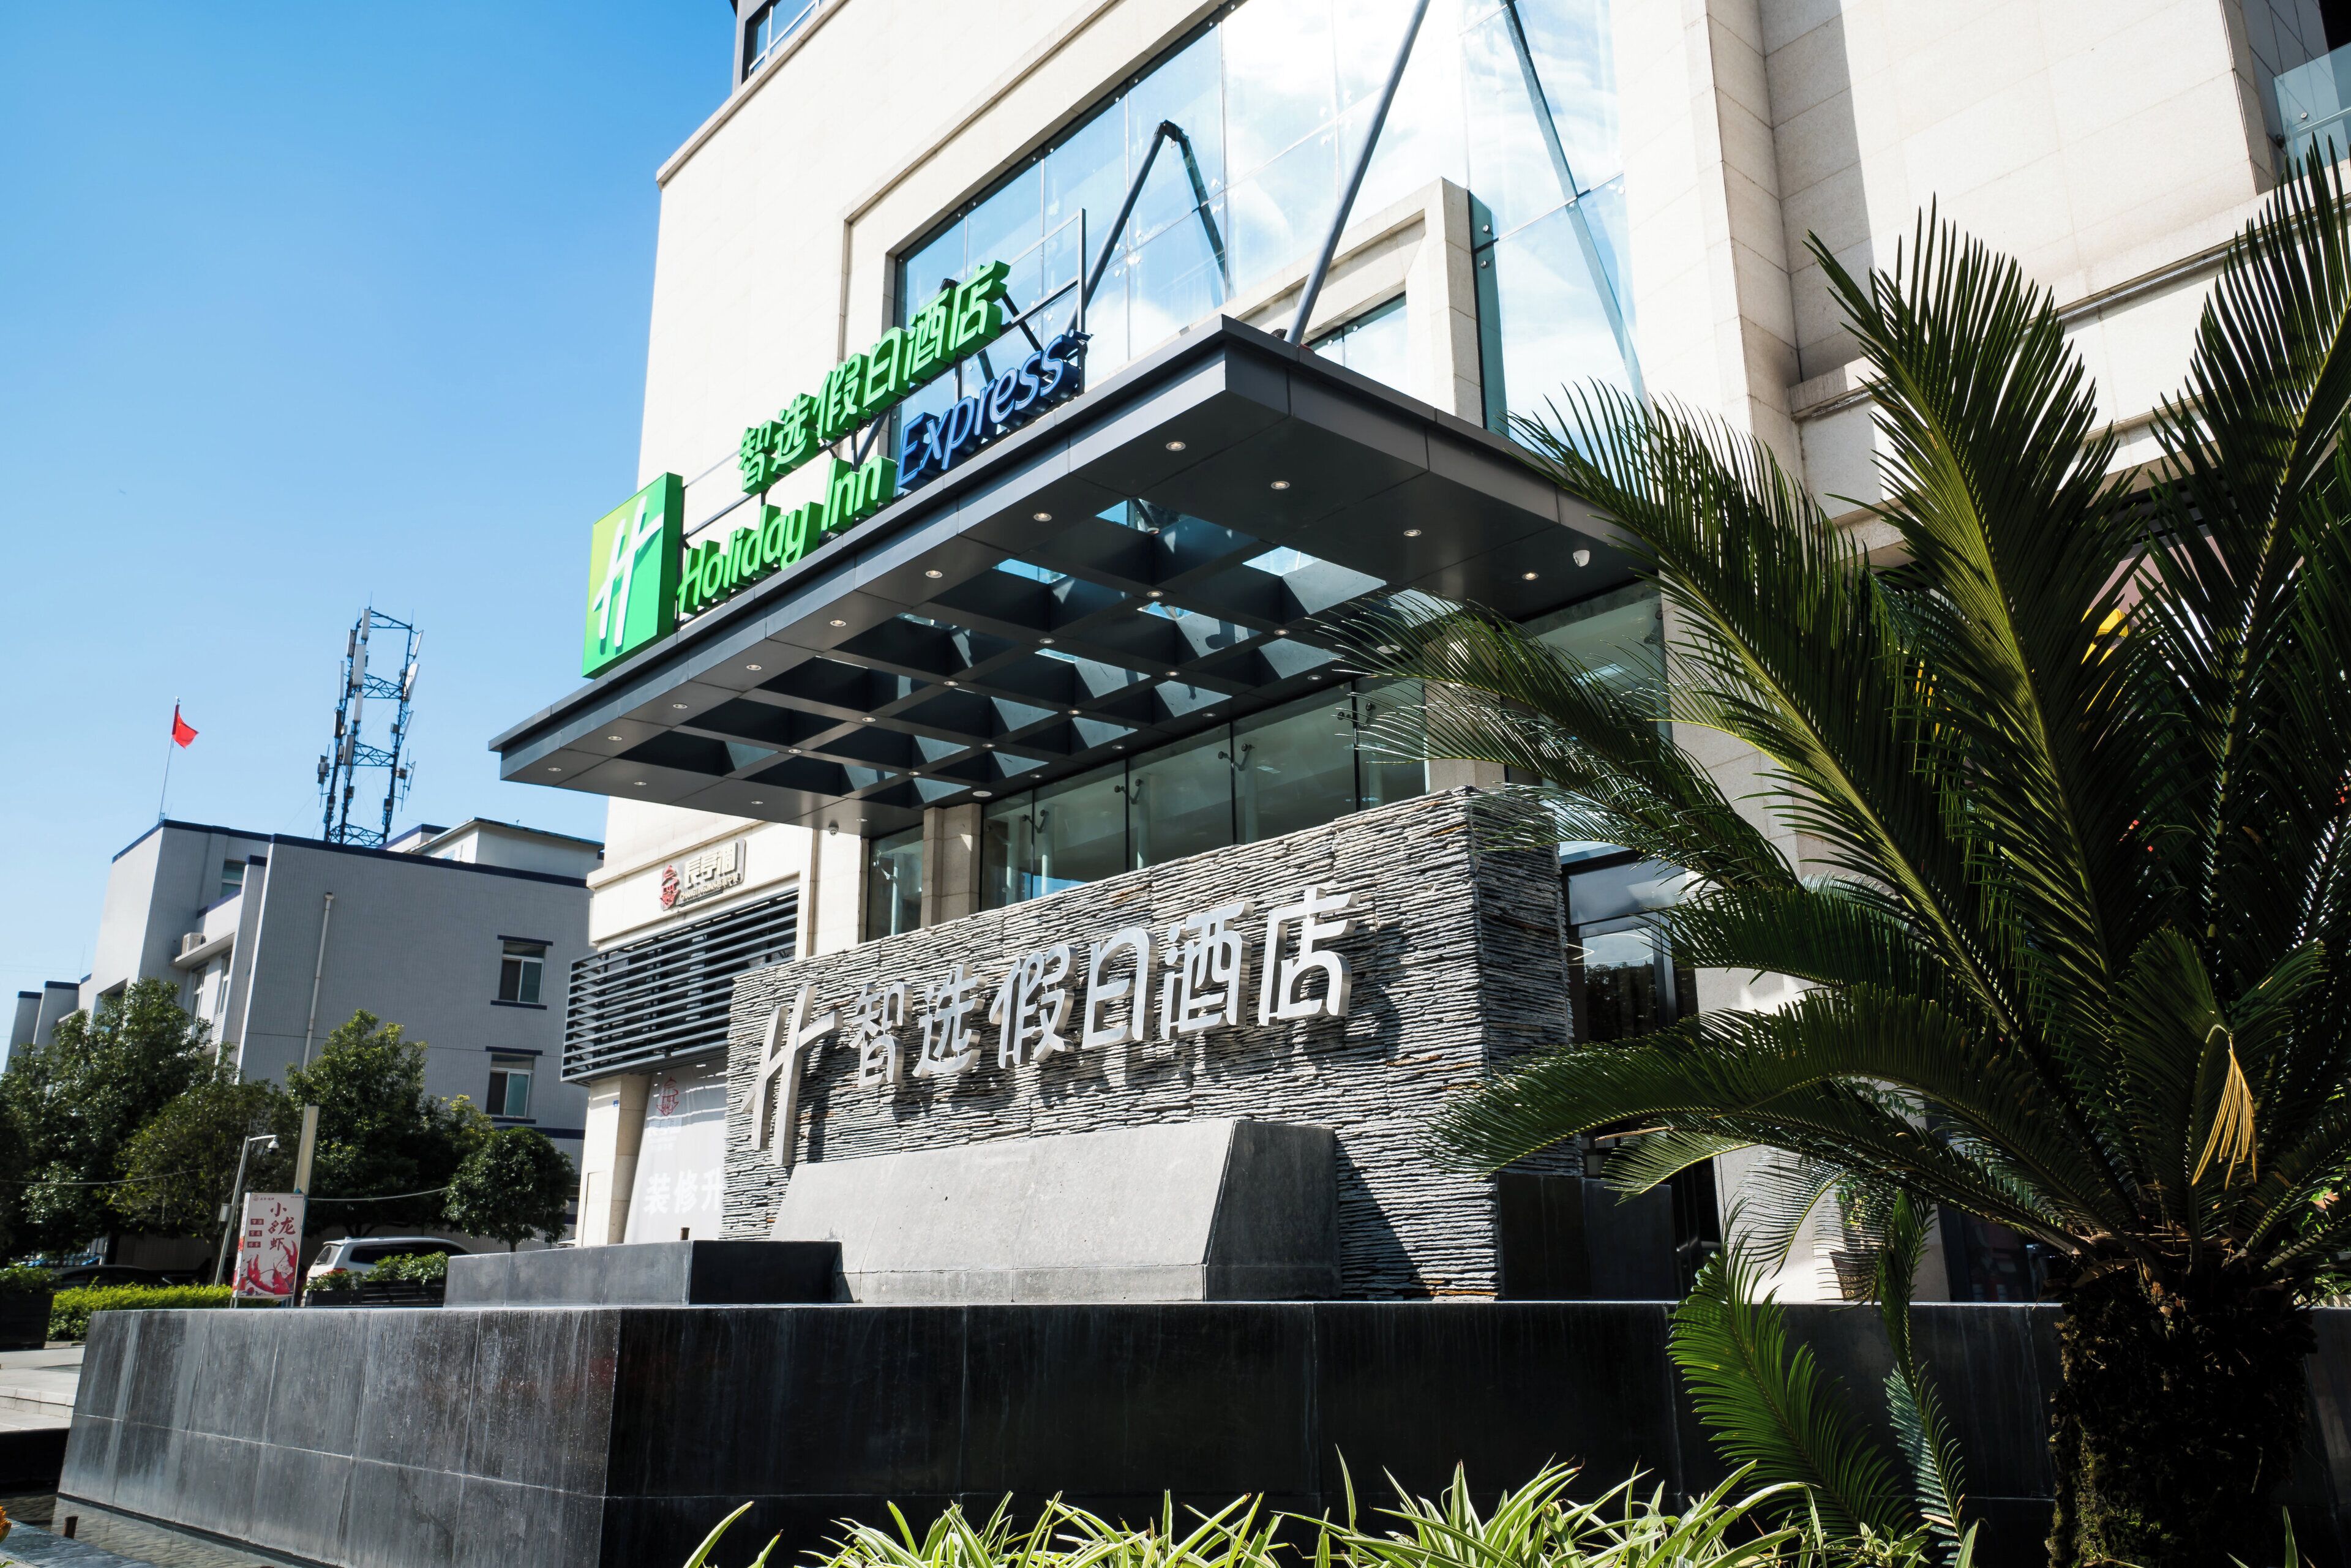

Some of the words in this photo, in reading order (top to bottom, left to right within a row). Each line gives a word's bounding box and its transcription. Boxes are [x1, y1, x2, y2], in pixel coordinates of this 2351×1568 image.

[678, 502, 820, 613] Holiday
[822, 456, 895, 533] Inn
[897, 334, 1079, 488] Express
[738, 260, 1010, 495] 智选假日酒店
[848, 887, 1360, 1089] 智选假日酒店
